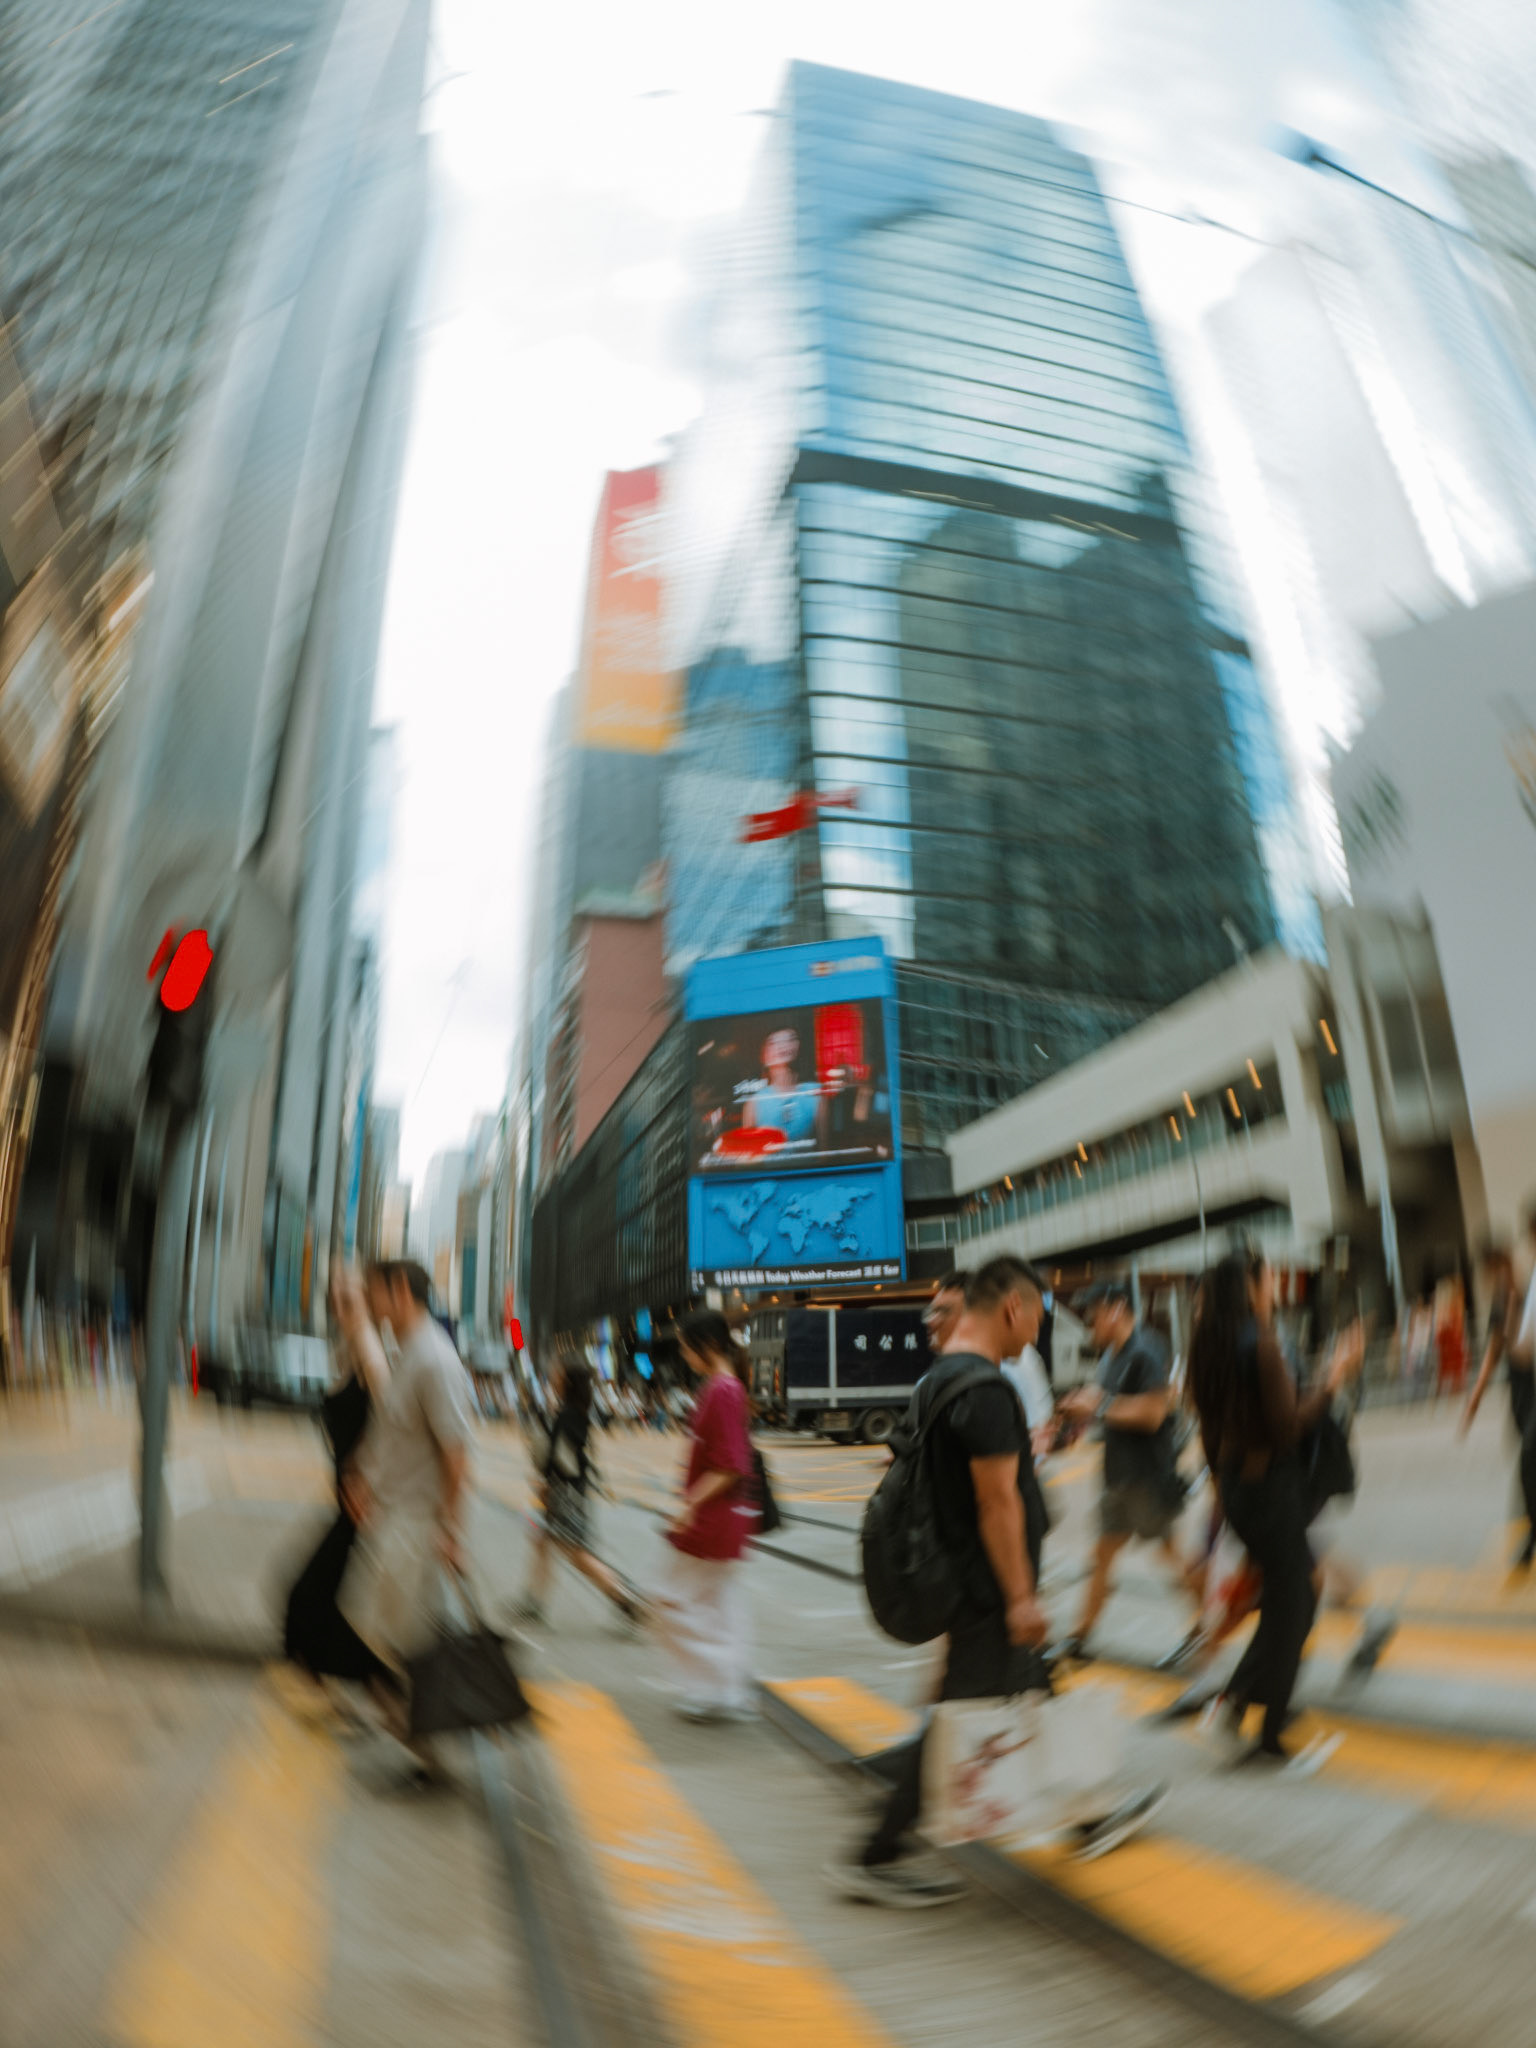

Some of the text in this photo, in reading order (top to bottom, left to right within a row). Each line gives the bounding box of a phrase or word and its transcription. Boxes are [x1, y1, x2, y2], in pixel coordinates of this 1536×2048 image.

[765, 1270, 790, 1284] Today
[791, 1270, 825, 1281] Weather
[826, 1267, 862, 1280] Forecast
